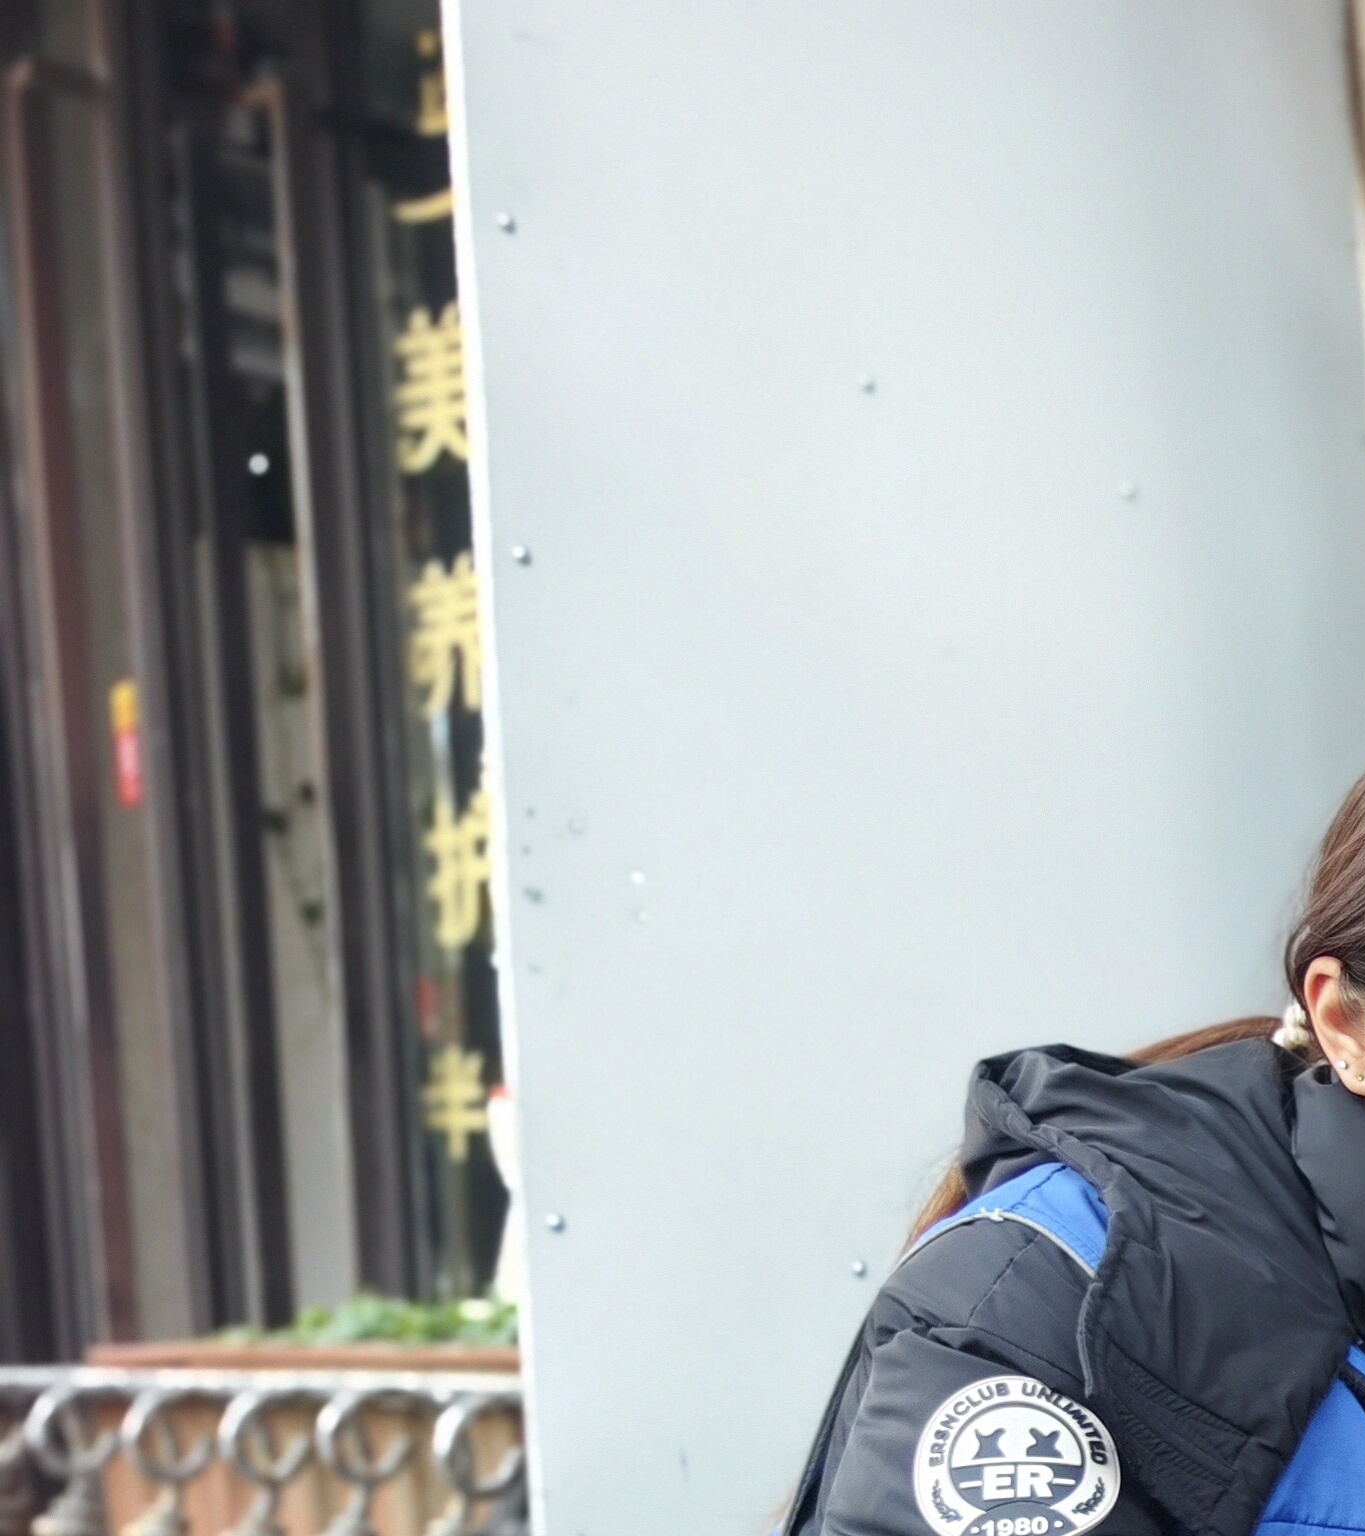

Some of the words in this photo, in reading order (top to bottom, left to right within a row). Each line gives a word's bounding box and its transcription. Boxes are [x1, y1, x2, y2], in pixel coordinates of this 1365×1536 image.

[929, 1382, 1010, 1467] ERSNCLUB
[1021, 1382, 1108, 1466] UNLIMITED
[982, 1464, 1054, 1501] ER
